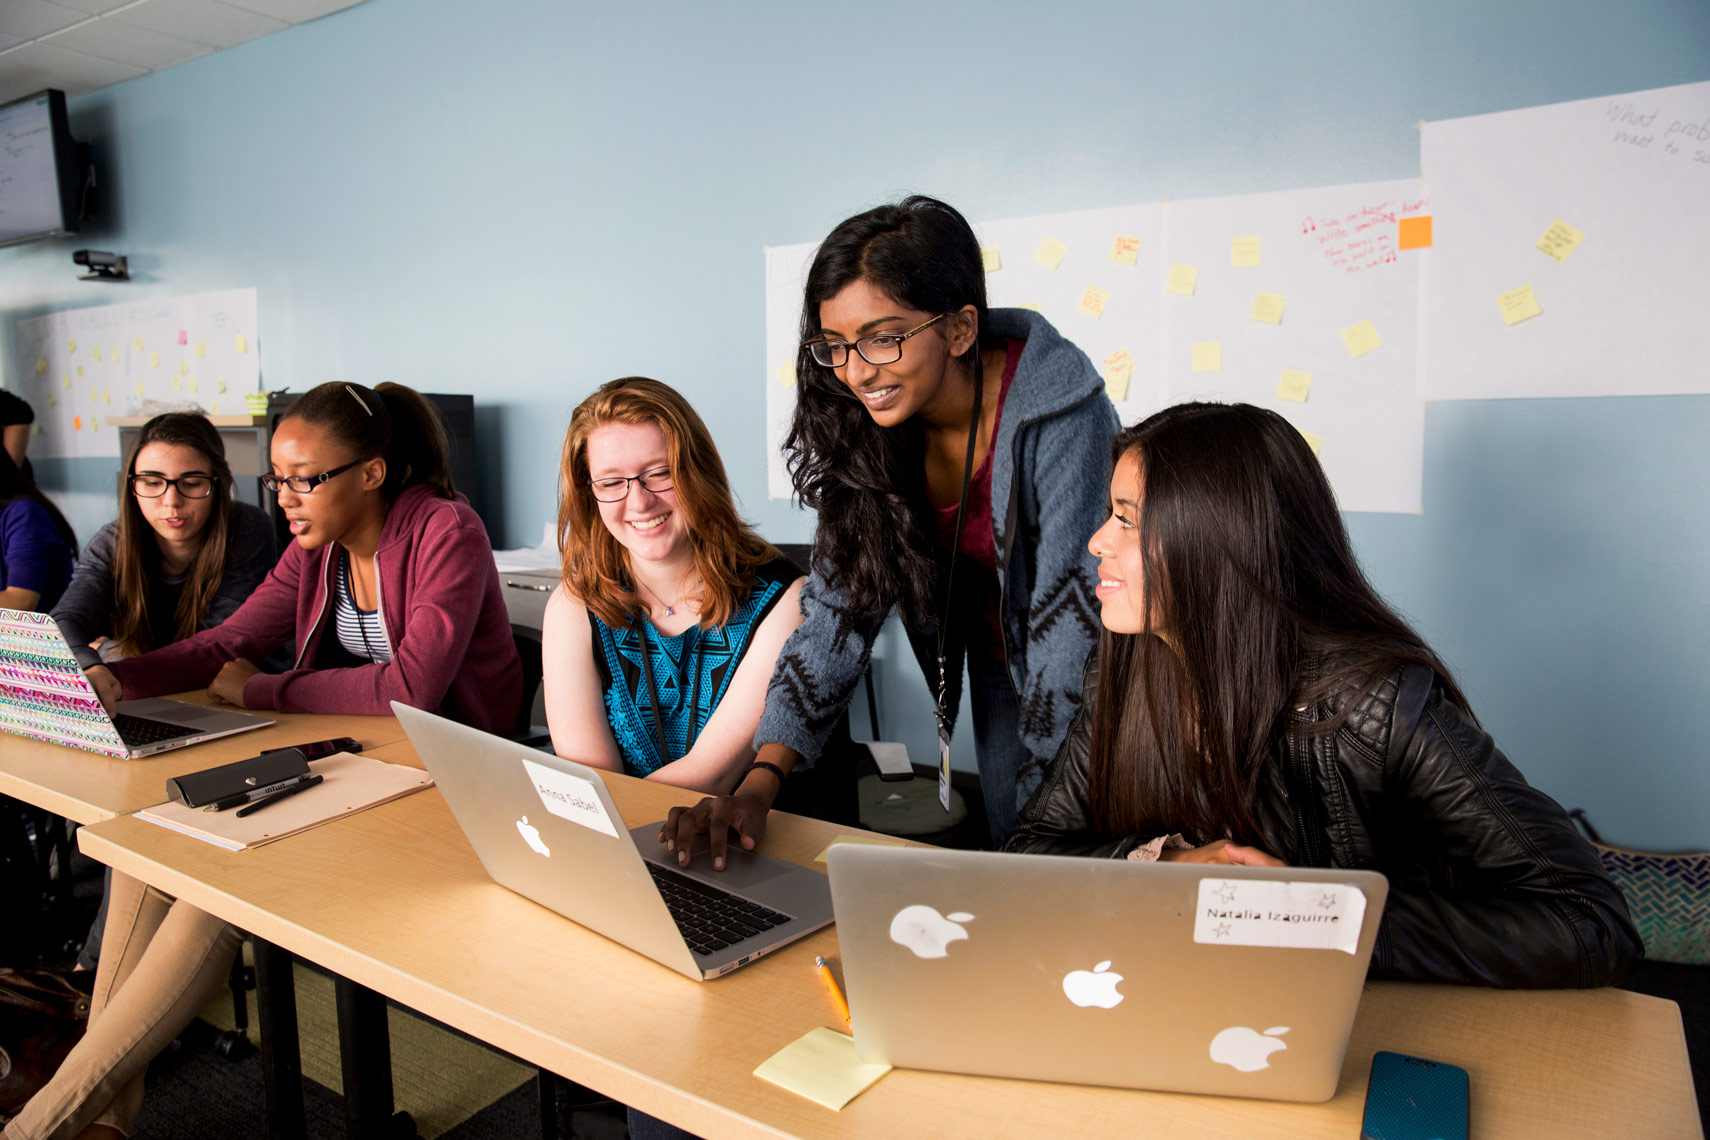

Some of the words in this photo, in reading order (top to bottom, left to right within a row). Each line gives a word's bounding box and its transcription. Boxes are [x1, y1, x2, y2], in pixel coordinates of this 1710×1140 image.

[1606, 99, 1661, 128] What
[539, 784, 567, 804] Anna
[567, 794, 600, 815] Sabel
[1207, 908, 1262, 921] Natalia
[1268, 911, 1341, 924] Izaguirre
